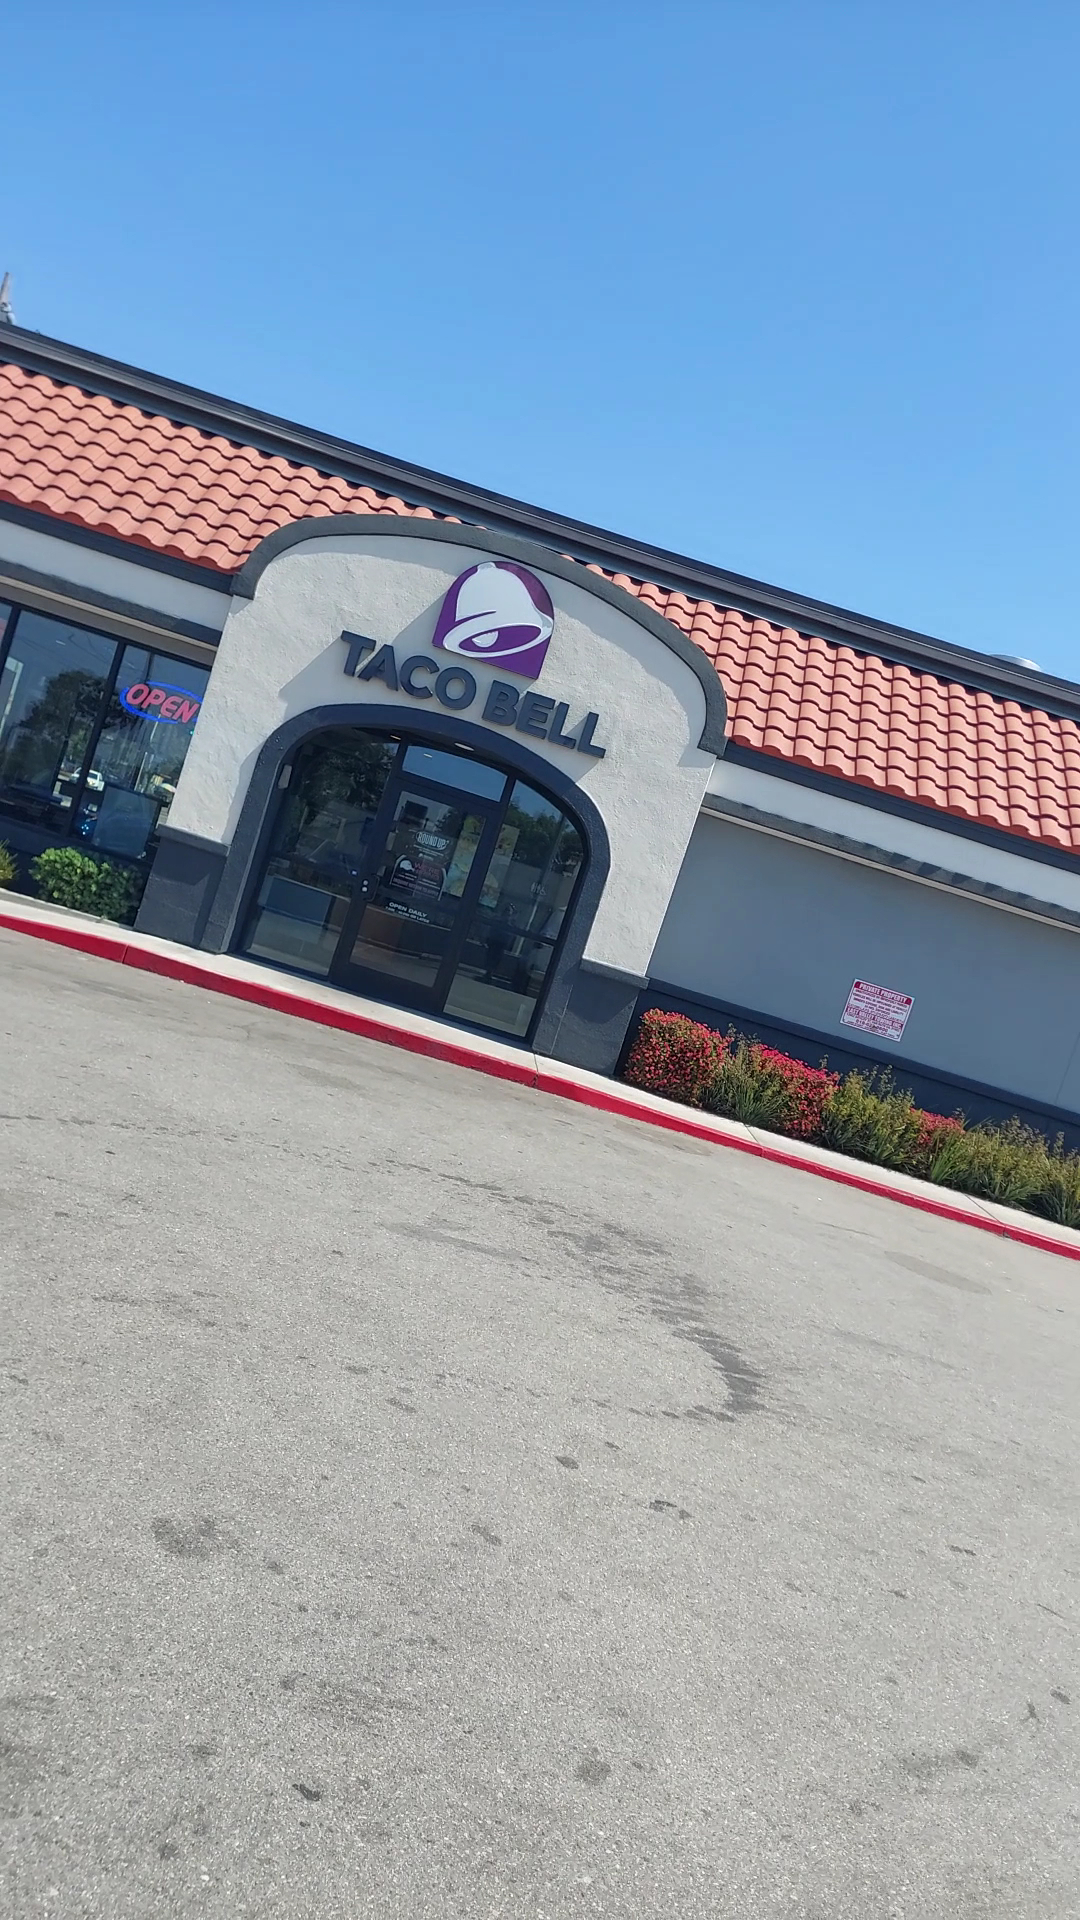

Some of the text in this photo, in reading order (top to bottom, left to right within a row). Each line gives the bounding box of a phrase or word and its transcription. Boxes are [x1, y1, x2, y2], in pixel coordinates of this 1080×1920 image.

[126, 683, 200, 723] OPEN
[341, 630, 606, 759] TACO BELL
[418, 831, 447, 848] ROUND UP
[389, 902, 408, 912] OPEN
[408, 908, 428, 918] DAILY
[859, 983, 881, 994] PRIVATE
[880, 990, 907, 1003] PROPERTY
